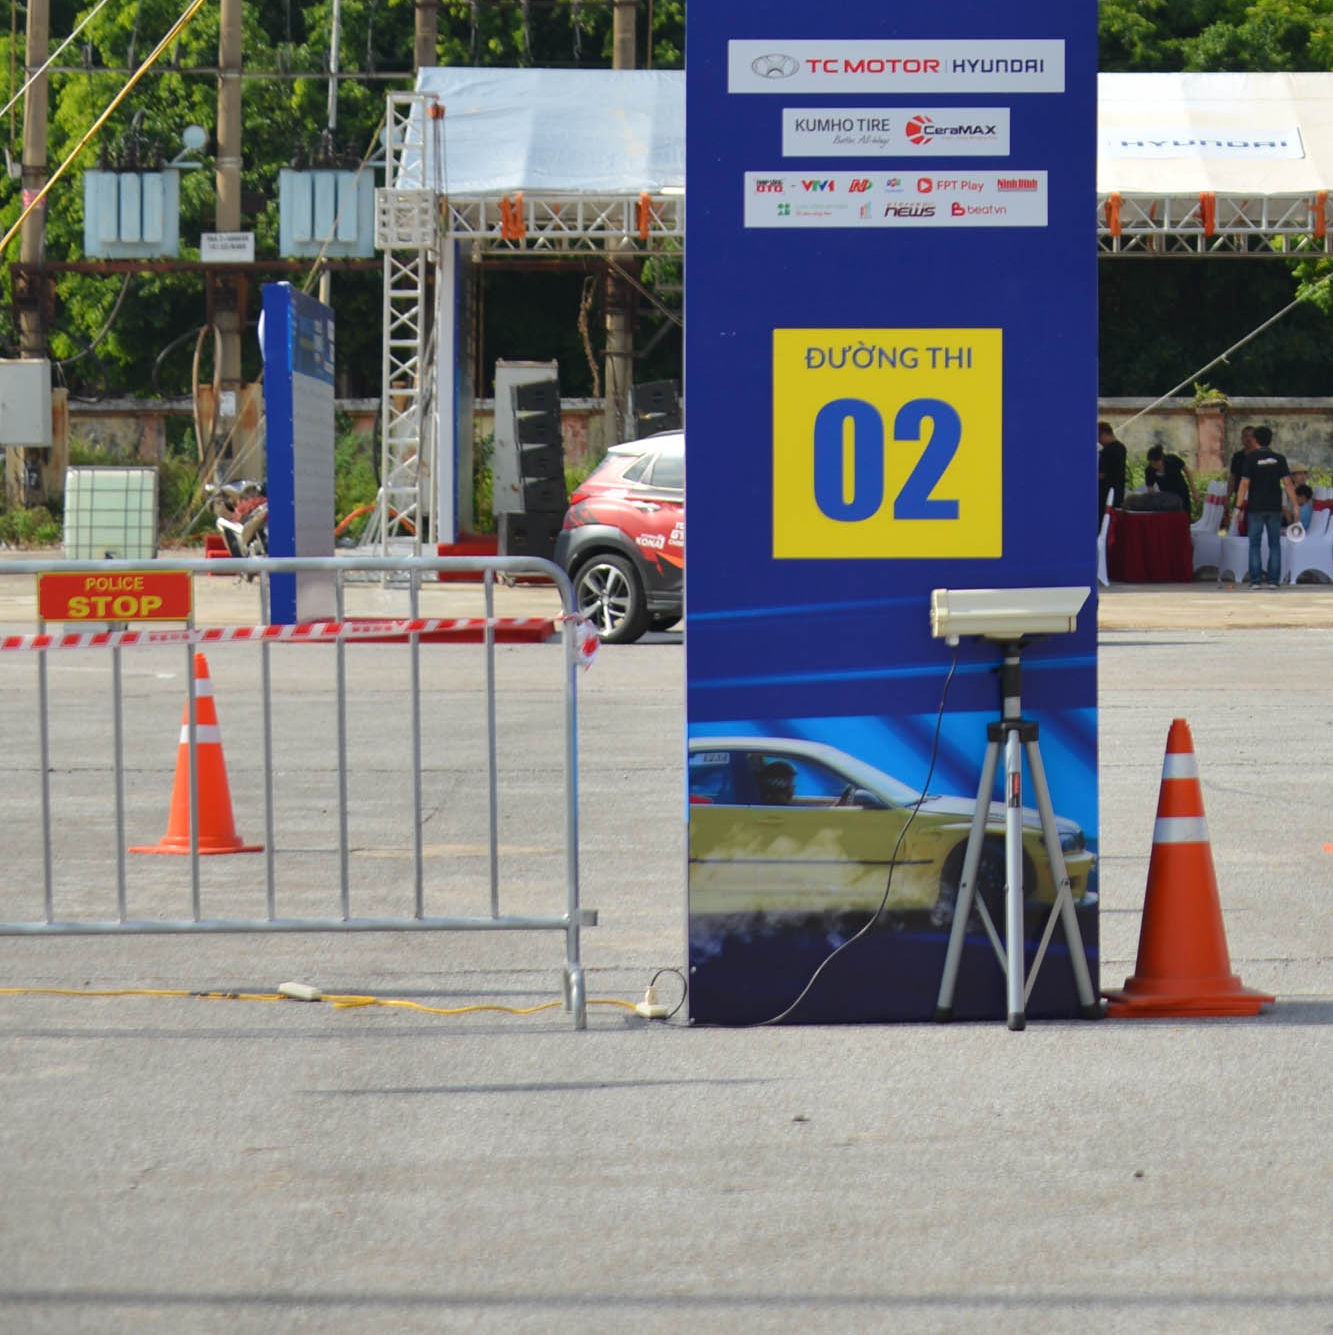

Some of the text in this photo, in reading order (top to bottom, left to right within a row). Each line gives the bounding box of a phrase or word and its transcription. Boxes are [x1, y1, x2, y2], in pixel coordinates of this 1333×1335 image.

[805, 58, 1044, 74] TC MOTOR HYUNDAI
[795, 118, 890, 132] KUMHO TIRE
[924, 125, 997, 135] CeraMAX
[937, 180, 958, 191] FPT
[961, 180, 985, 193] Play
[804, 341, 973, 370] ĐƯỜNG THI
[813, 397, 963, 523] 02
[85, 576, 144, 592] POLICE
[67, 595, 163, 618] STOP
